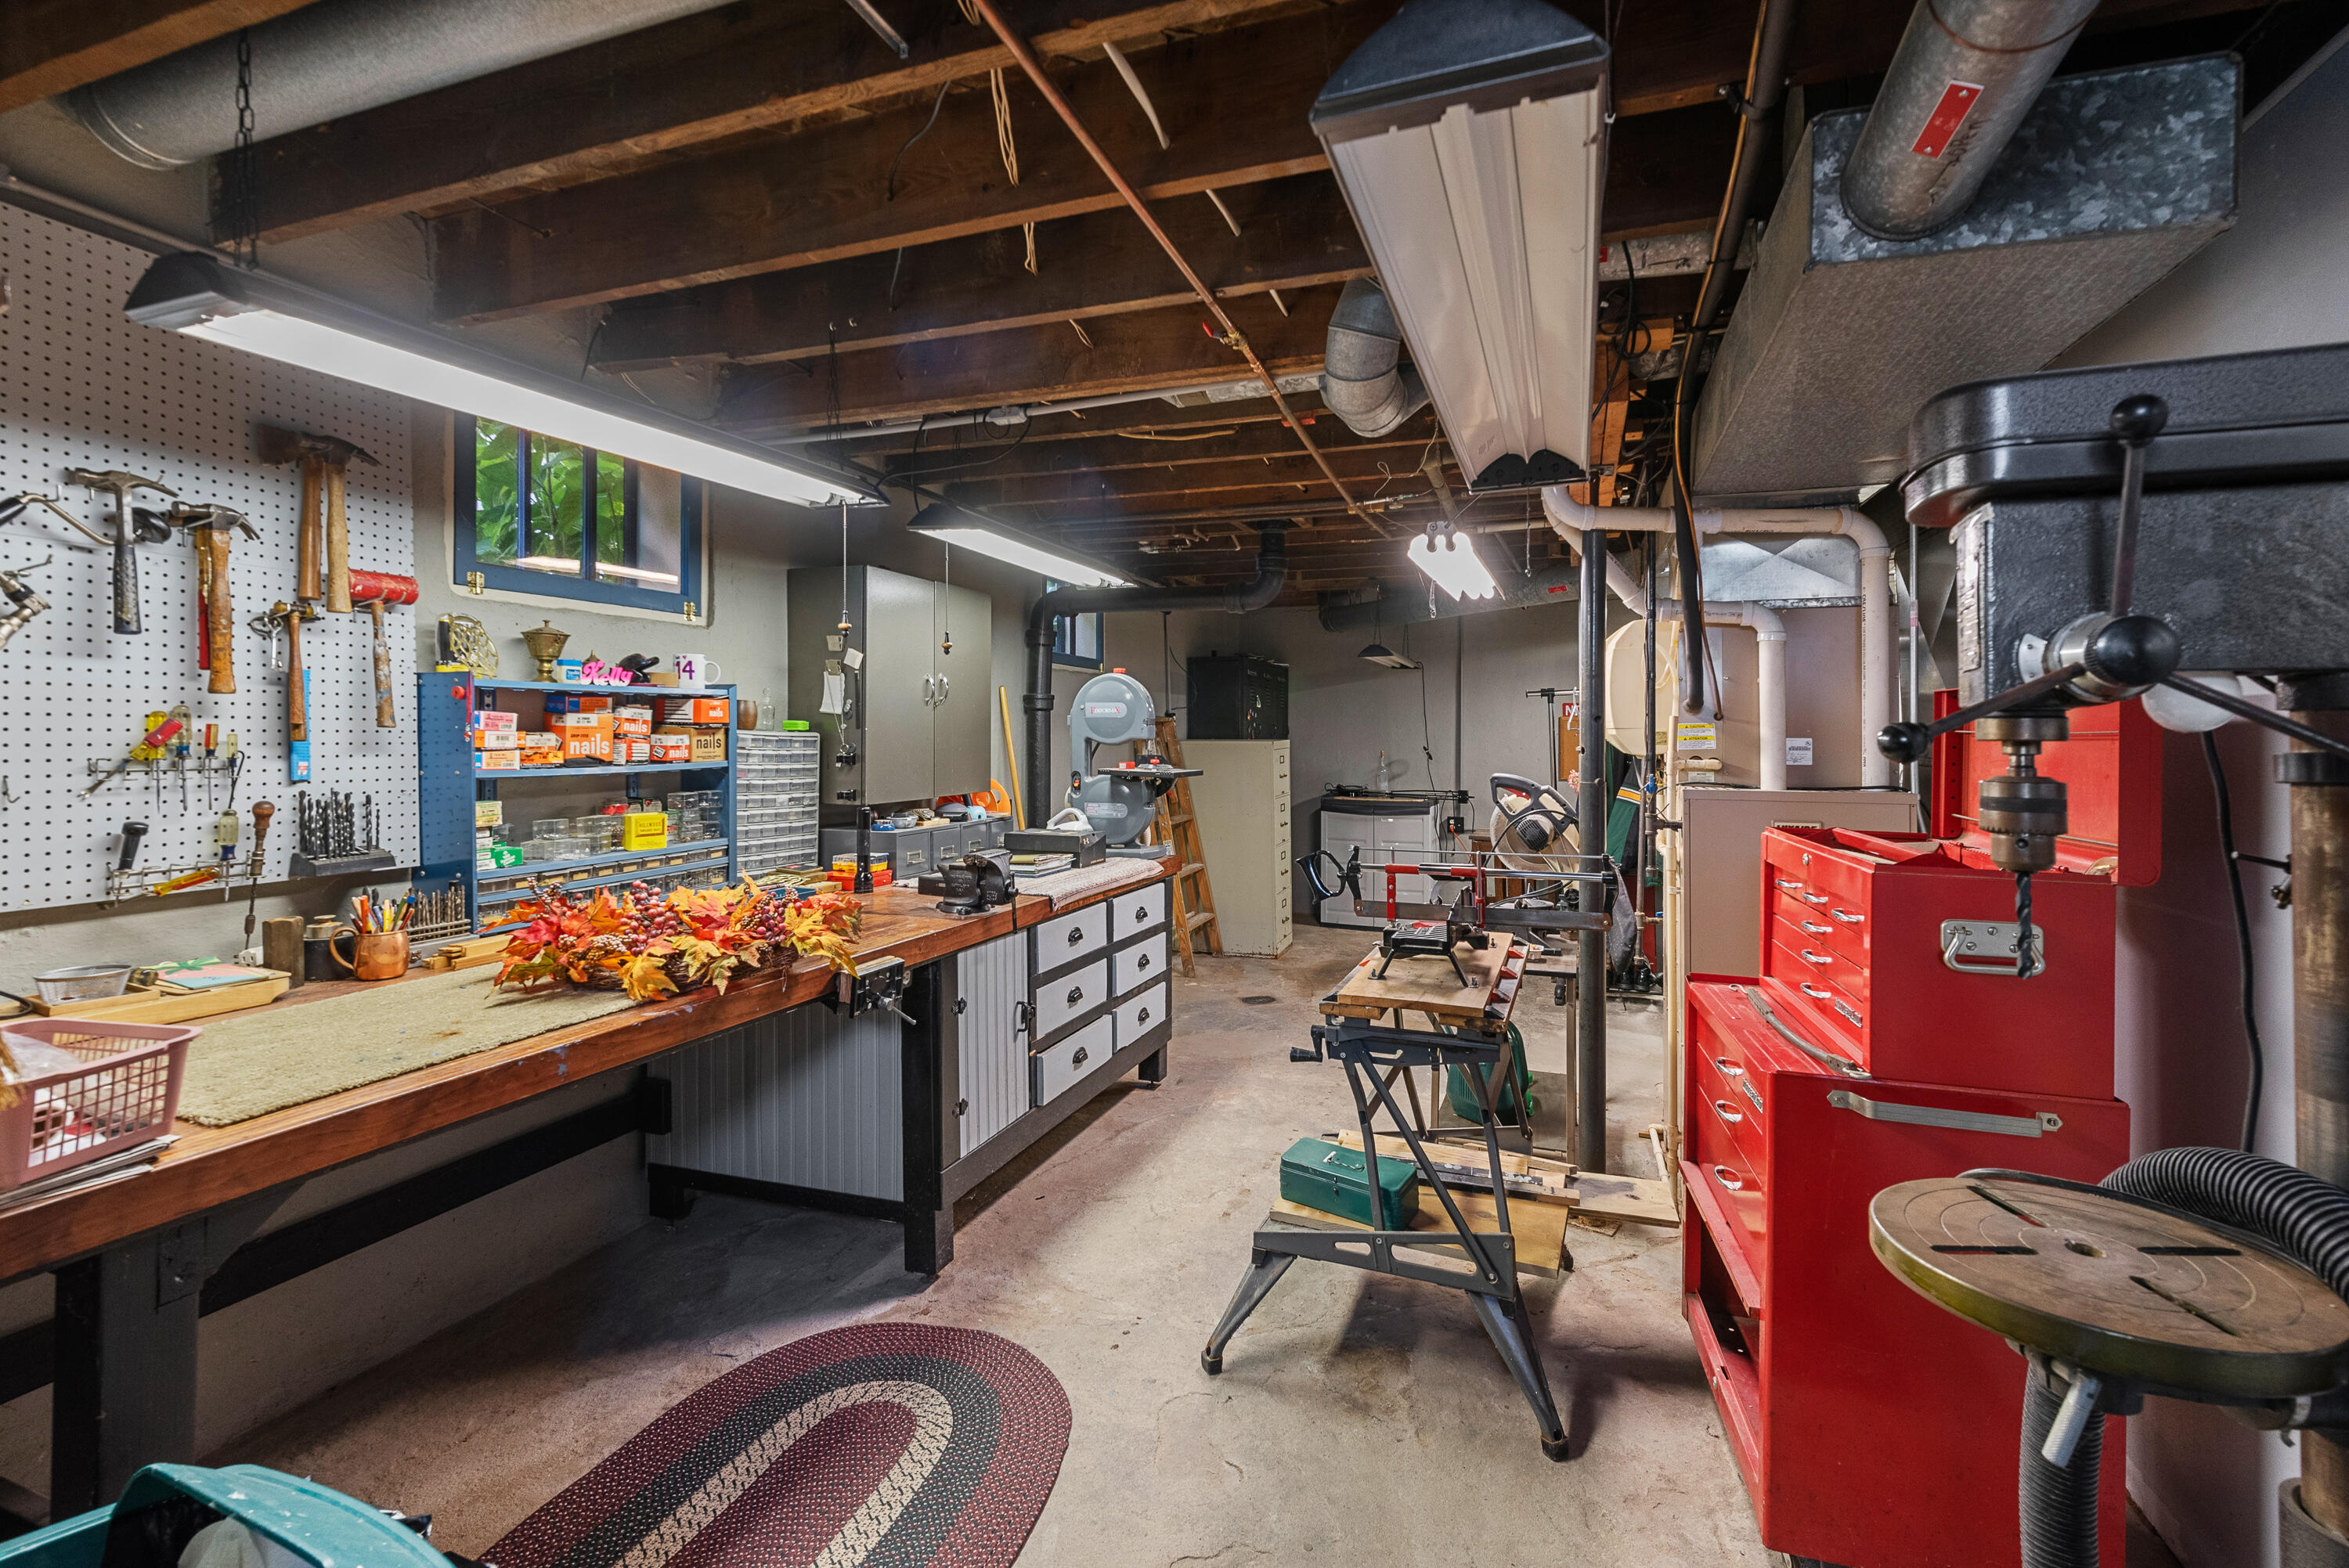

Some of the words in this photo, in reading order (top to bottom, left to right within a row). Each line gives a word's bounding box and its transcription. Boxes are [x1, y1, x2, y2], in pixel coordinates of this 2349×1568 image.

[581, 660, 633, 687] Kelly
[675, 660, 695, 680] 14
[708, 707, 724, 718] nails
[623, 719, 648, 734] nails
[569, 733, 611, 756] nails
[696, 732, 722, 750] nails
[669, 744, 689, 759] nails
